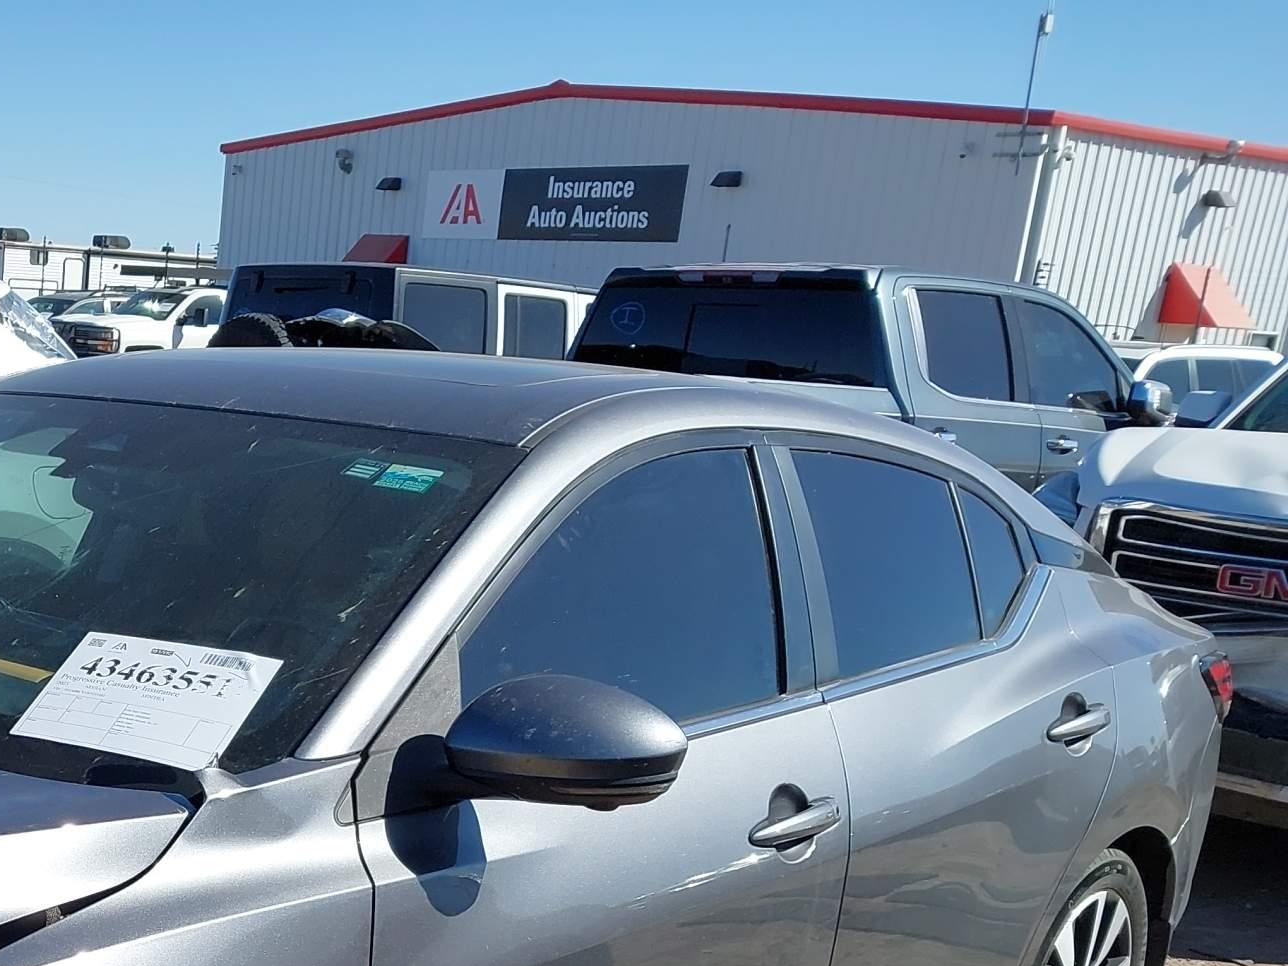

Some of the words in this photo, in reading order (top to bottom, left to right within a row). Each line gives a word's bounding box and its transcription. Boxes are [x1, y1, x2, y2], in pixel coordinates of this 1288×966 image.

[547, 175, 635, 200] Insurance
[526, 205, 566, 230] Auto
[570, 204, 649, 230] Auctions
[60, 673, 106, 685] Progressive
[106, 678, 139, 691] Casualty
[141, 686, 181, 698] Insurance
